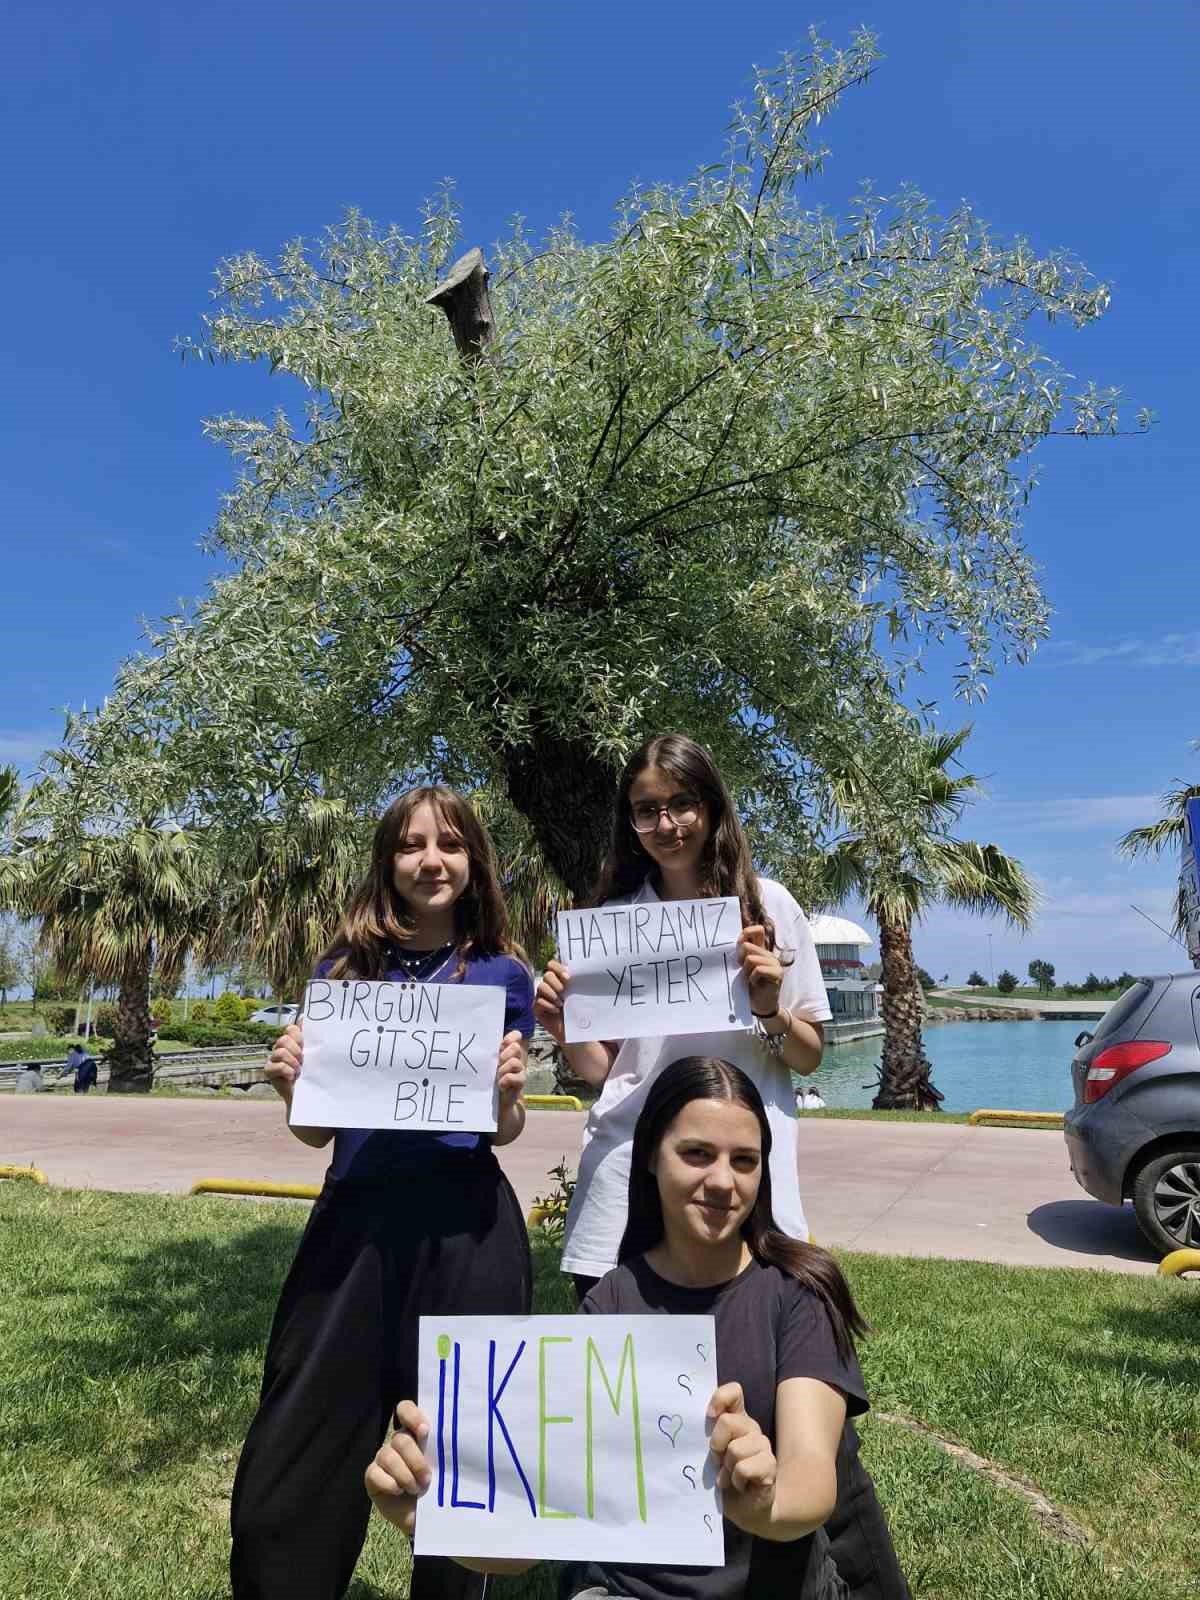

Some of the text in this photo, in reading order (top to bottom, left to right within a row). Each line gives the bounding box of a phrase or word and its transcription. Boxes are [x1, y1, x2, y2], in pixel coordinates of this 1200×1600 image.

[566, 901, 735, 961] HATIRAMIZ
[606, 955, 709, 1007] YETER
[349, 1025, 479, 1074] GİTSEK
[393, 1077, 468, 1123] BİLE
[436, 1332, 648, 1524] İLKEM
